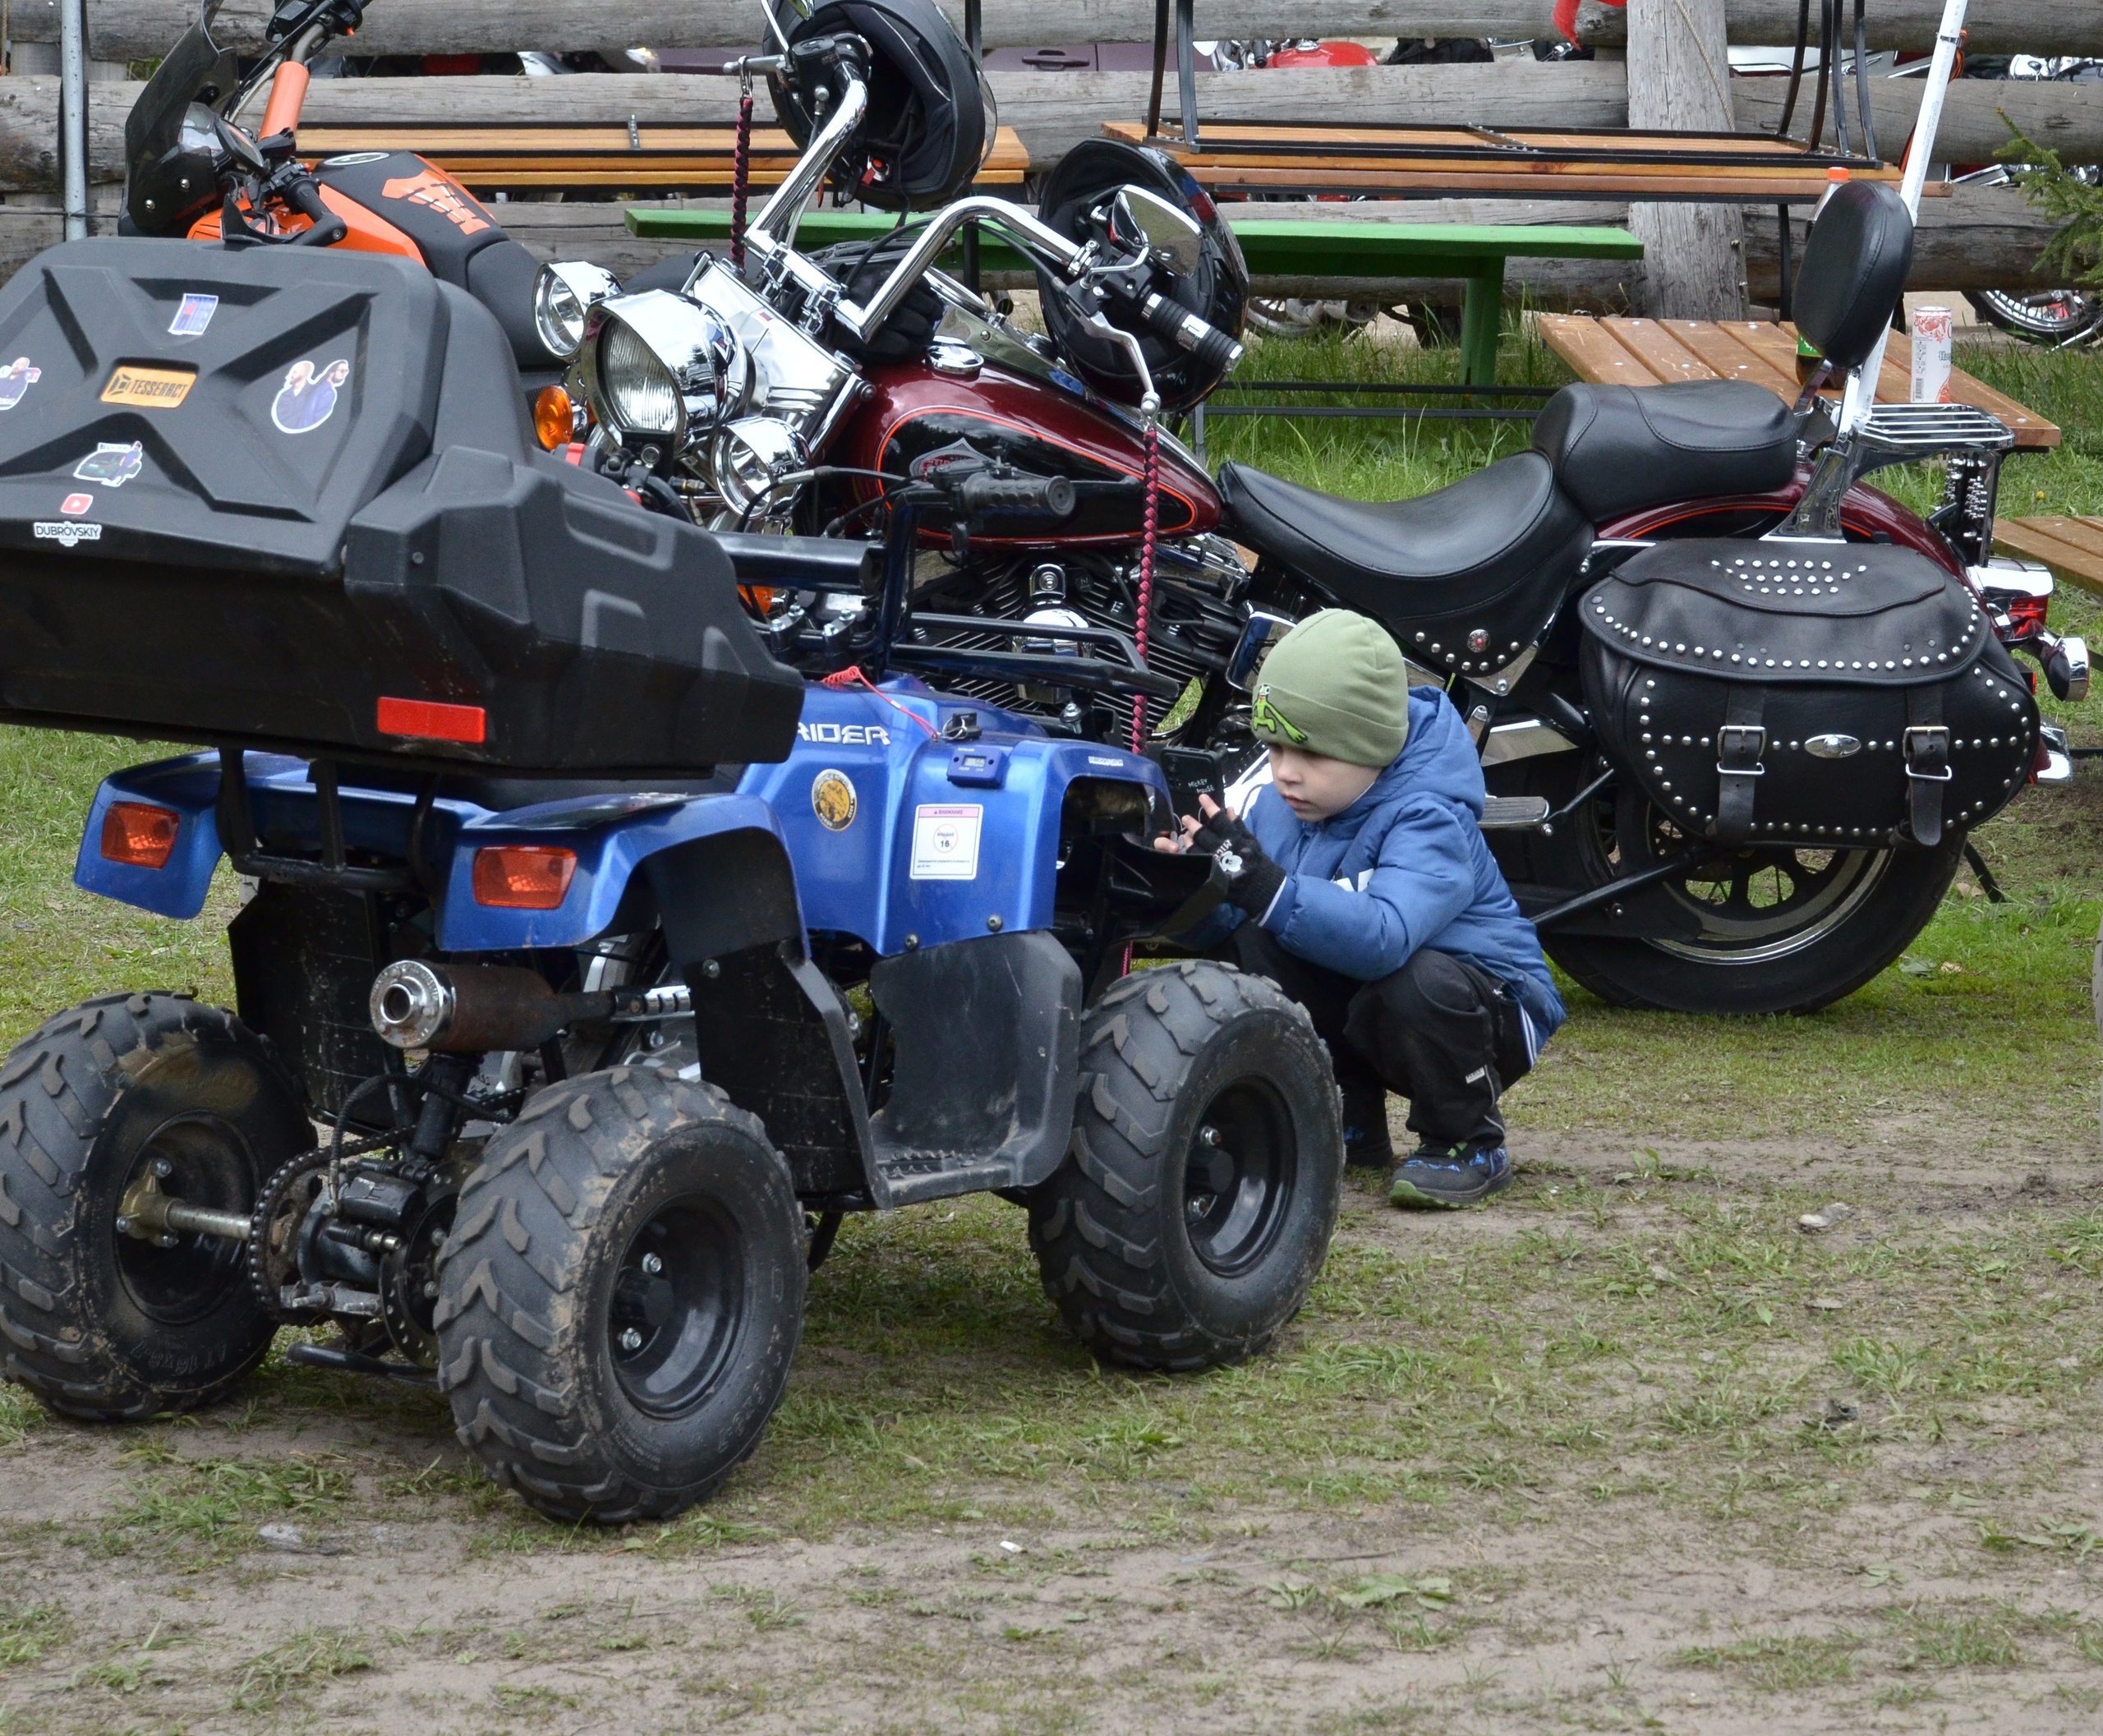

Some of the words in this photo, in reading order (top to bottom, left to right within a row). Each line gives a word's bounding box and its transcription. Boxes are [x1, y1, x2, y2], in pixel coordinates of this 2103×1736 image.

[130, 379, 188, 398] TESSERACT
[35, 525, 99, 537] DUBROVSKIY
[941, 840, 950, 848] 16
